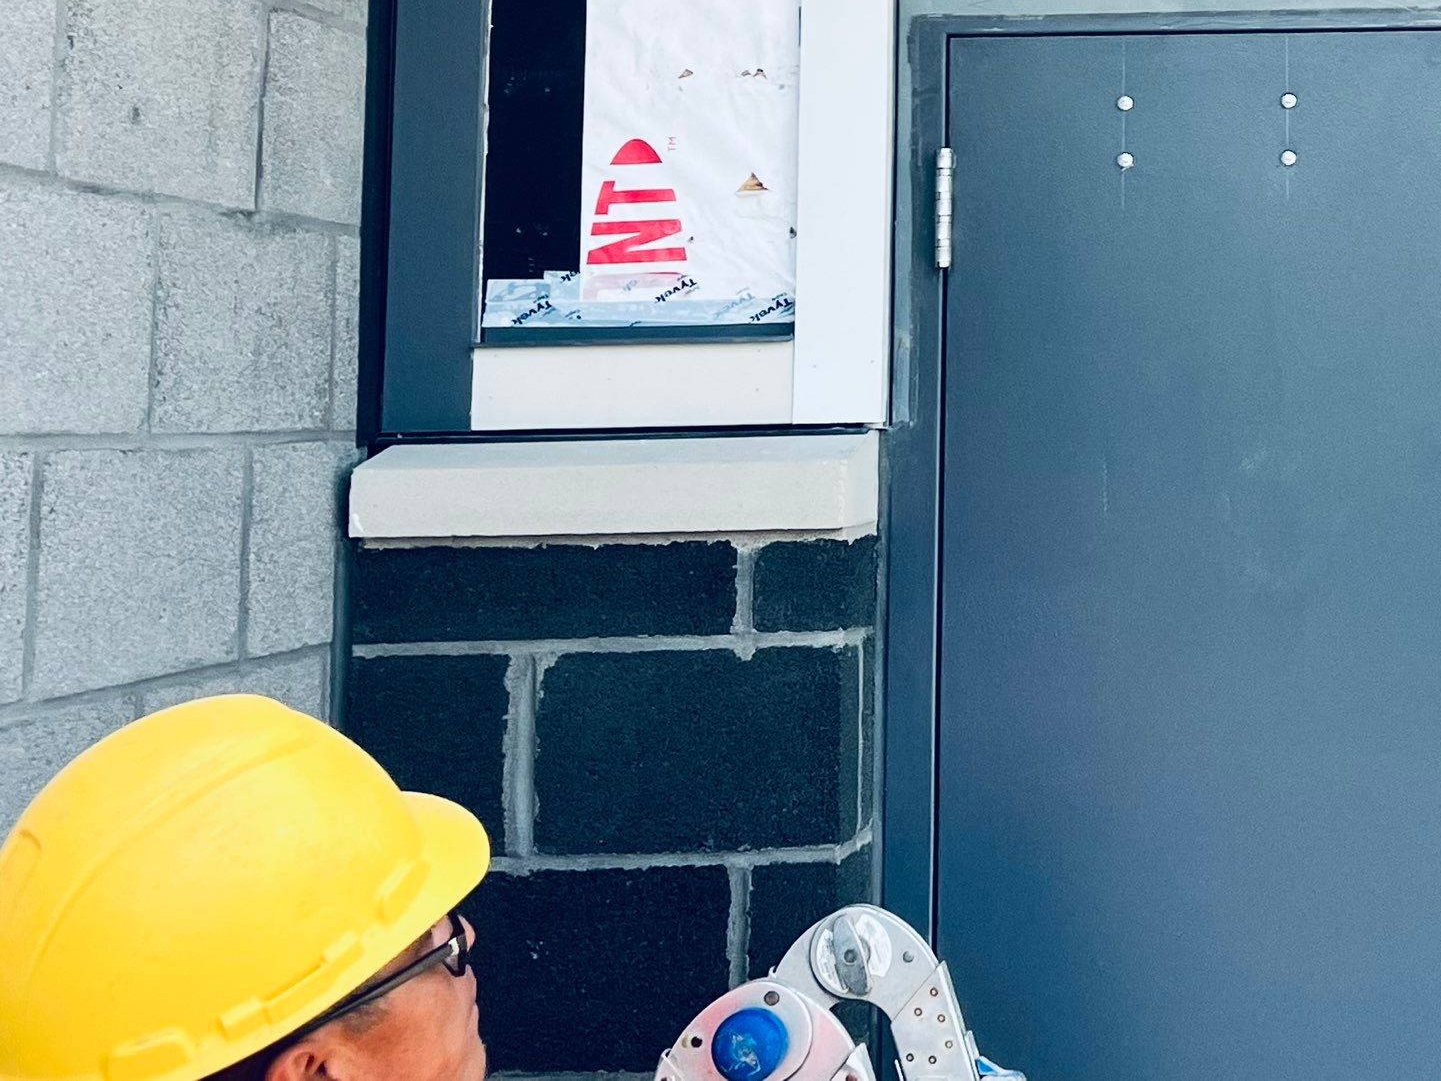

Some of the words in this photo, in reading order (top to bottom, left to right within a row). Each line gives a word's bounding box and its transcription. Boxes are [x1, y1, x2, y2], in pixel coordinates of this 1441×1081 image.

[583, 180, 688, 301] NT
[654, 278, 698, 303] Tyvek
[511, 300, 553, 325] Tyvek
[748, 297, 794, 324] Tyvek
